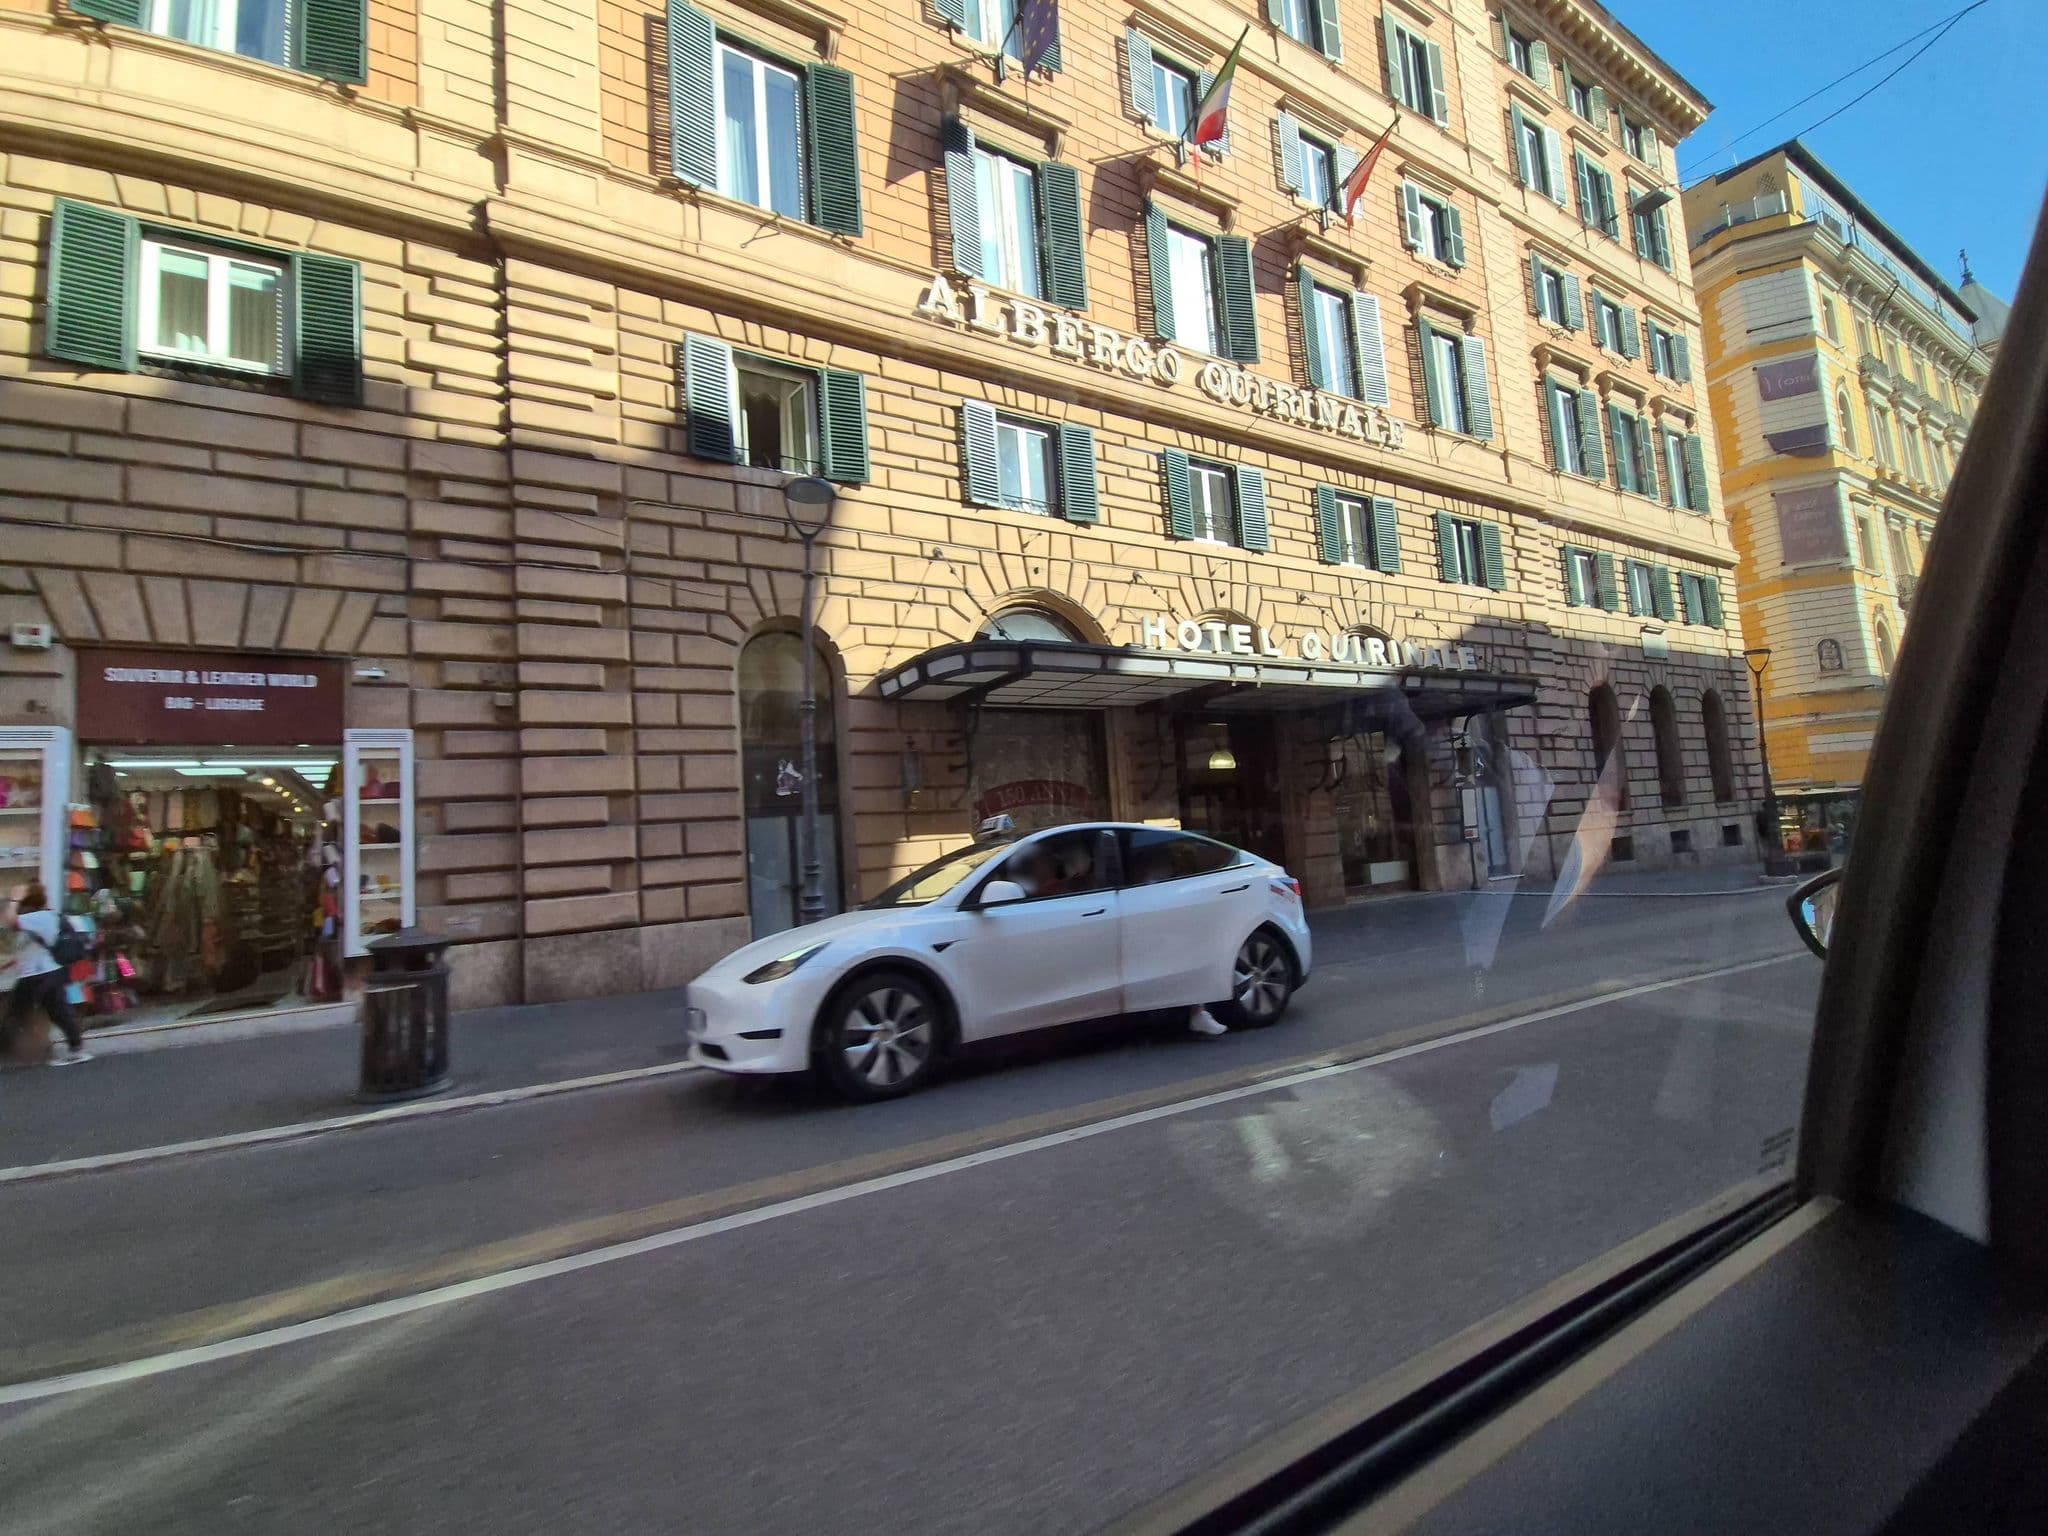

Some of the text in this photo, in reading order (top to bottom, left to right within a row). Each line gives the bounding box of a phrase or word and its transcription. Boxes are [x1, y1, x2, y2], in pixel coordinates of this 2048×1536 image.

[918, 275, 1407, 450] ALBERGO QUIRINALE
[1141, 616, 1480, 672] HOTEL QUIRINALE
[103, 667, 319, 688] SOUVENIR & LEATHER WORLD
[164, 696, 193, 710] BAG
[205, 697, 265, 711] LUGGAGE
